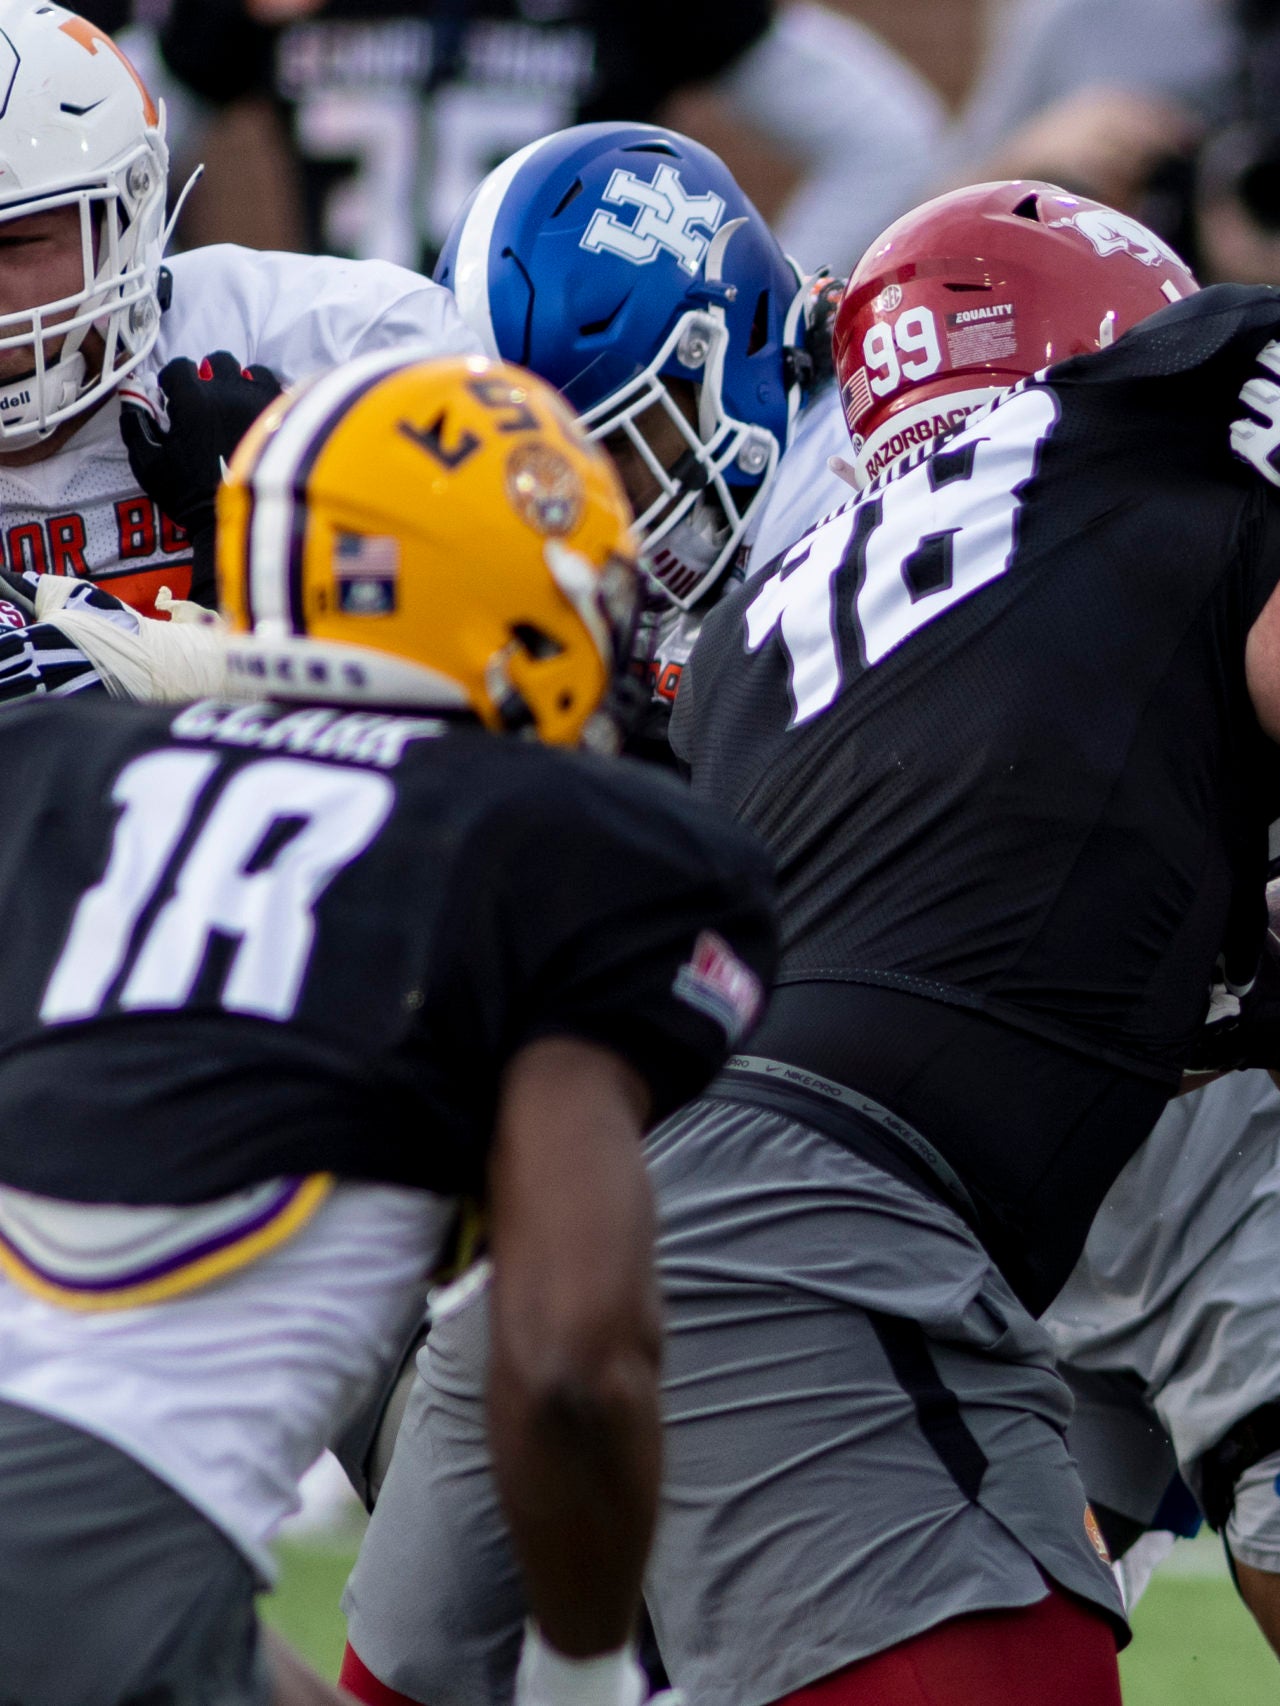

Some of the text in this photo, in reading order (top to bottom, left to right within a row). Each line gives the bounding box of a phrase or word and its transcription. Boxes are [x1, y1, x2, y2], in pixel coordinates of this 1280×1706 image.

[579, 162, 726, 278] UK
[863, 306, 942, 397] 99
[955, 303, 1013, 324] EQUALITY
[865, 404, 984, 481] RAZORBAC
[784, 1068, 842, 1097] NIKE PRO
